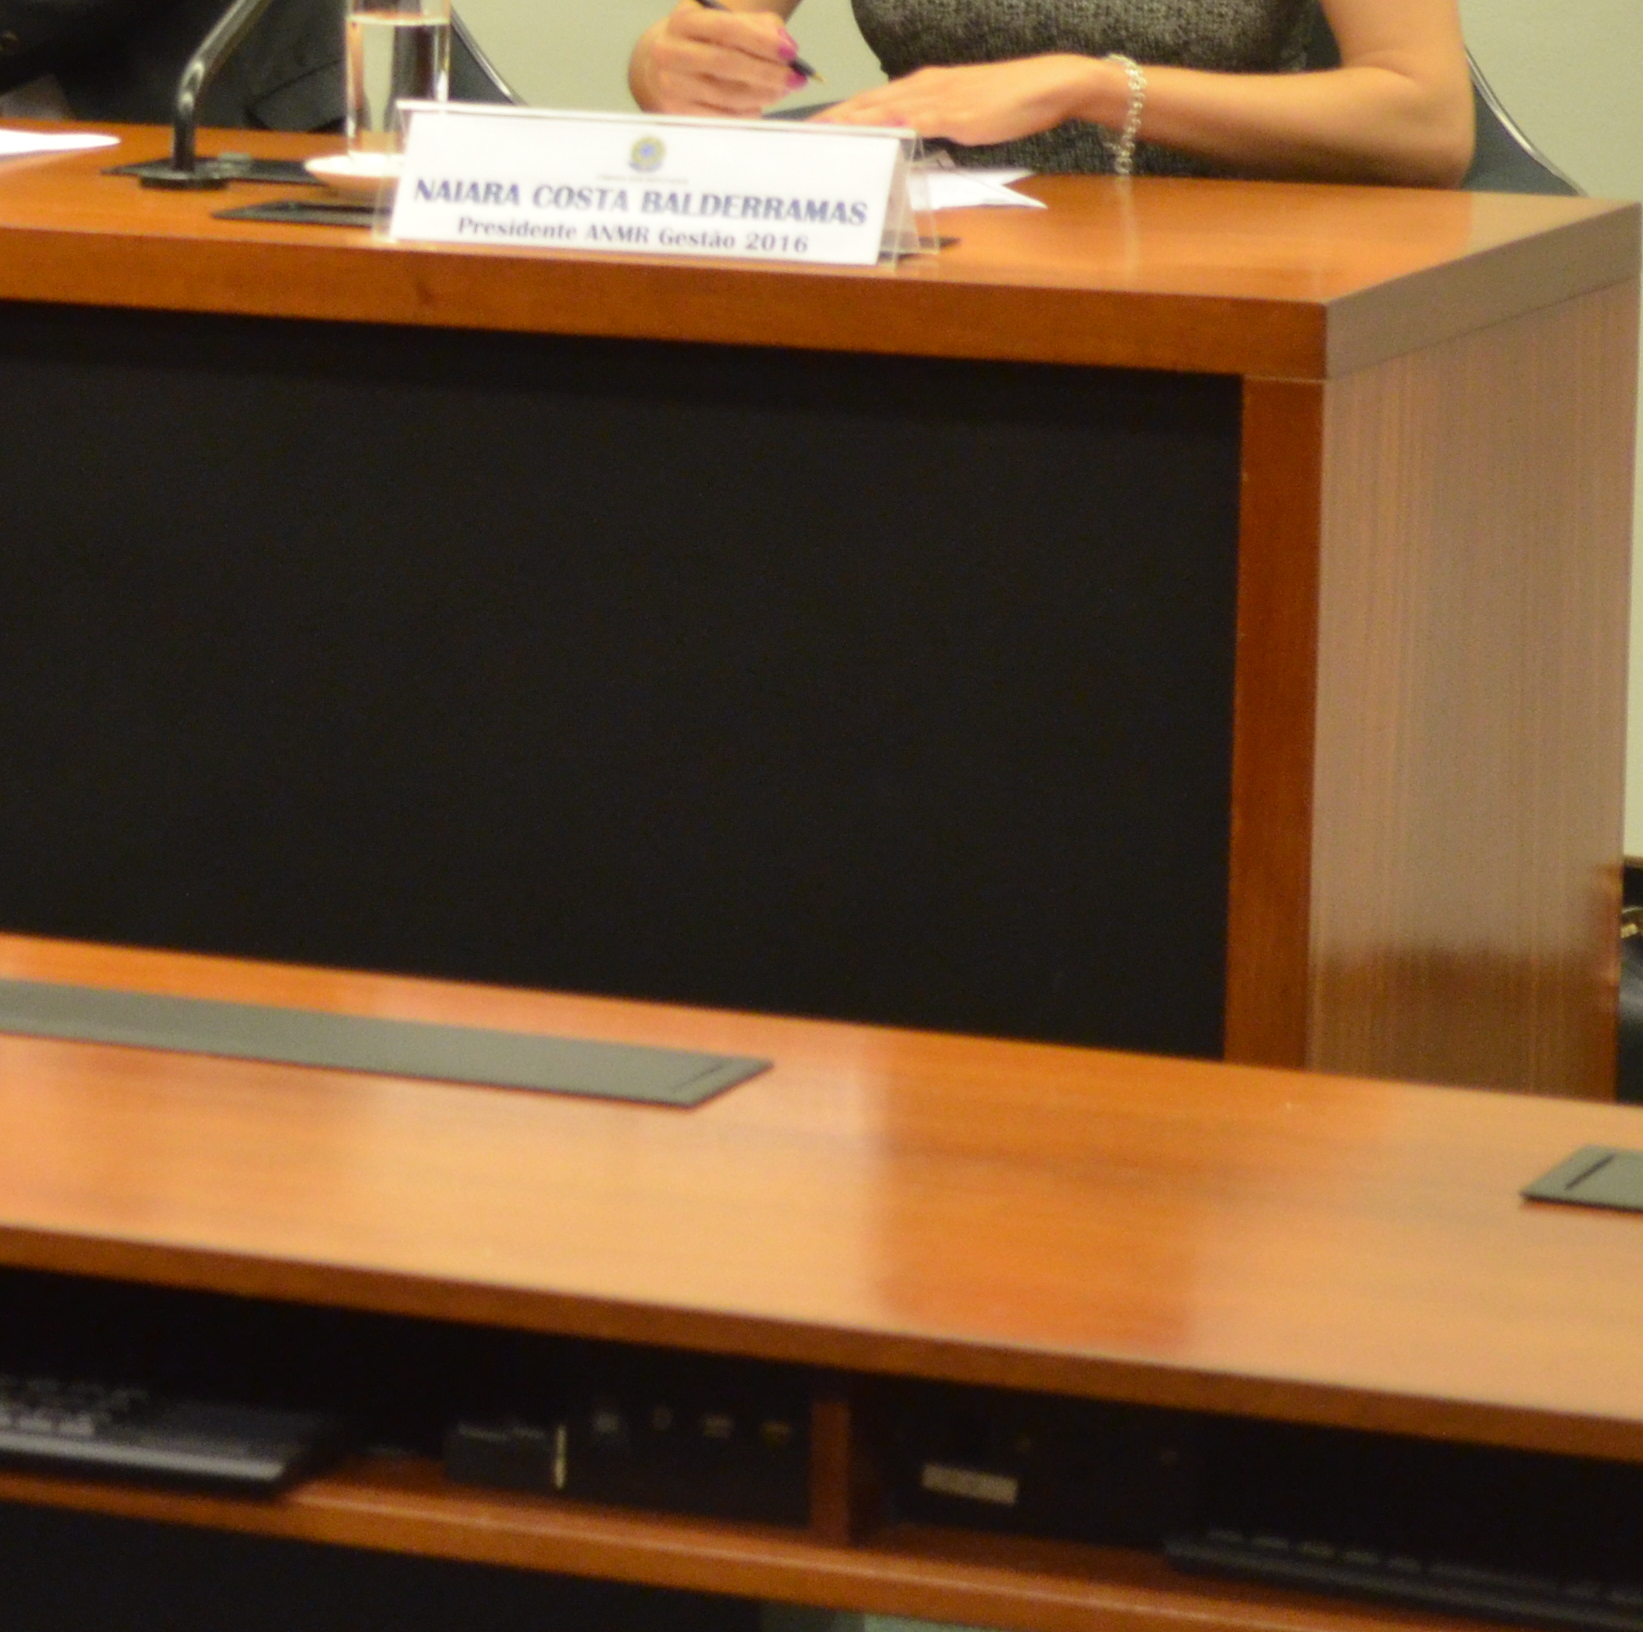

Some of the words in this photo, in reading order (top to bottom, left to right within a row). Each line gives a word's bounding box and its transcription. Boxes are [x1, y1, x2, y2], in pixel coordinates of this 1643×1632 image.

[414, 177, 521, 206] NAIARA
[533, 183, 630, 213] COSTA
[641, 189, 869, 226] BALDERRAMAS
[456, 215, 578, 242] Presidente
[585, 223, 650, 246] ANMR
[659, 227, 737, 252] Gestão
[746, 231, 810, 254] 2016
